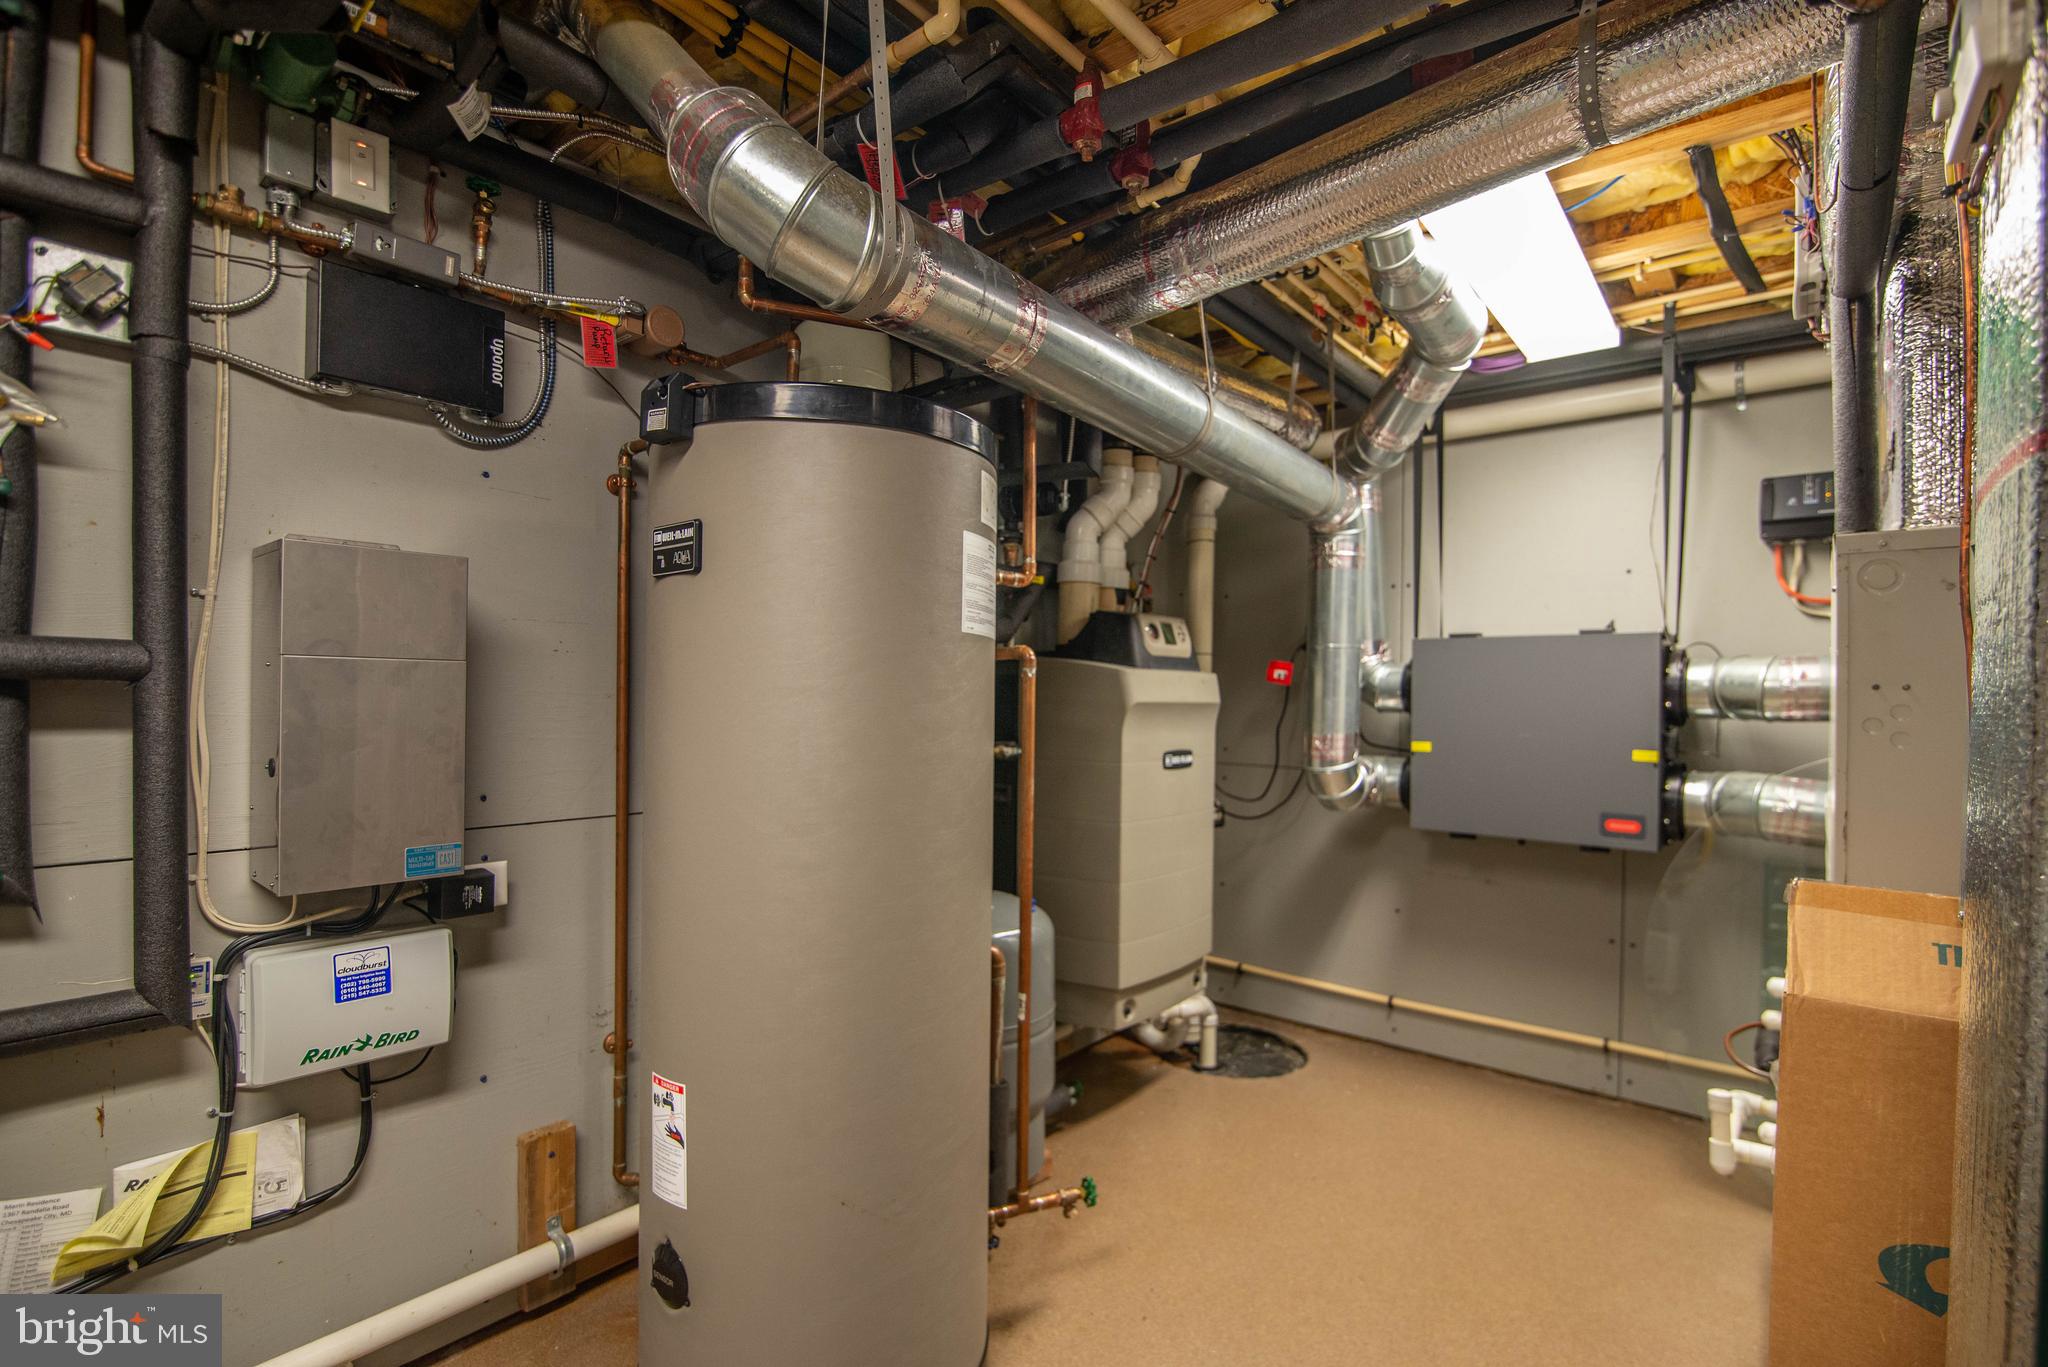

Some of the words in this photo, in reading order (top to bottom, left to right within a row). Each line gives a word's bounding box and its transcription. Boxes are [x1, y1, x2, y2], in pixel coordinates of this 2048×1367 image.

[490, 338, 503, 387] uponor
[337, 960, 387, 975] cloudburst
[299, 1044, 354, 1066] RAIN
[373, 1029, 420, 1049] BIRD
[52, 1203, 70, 1212] Road
